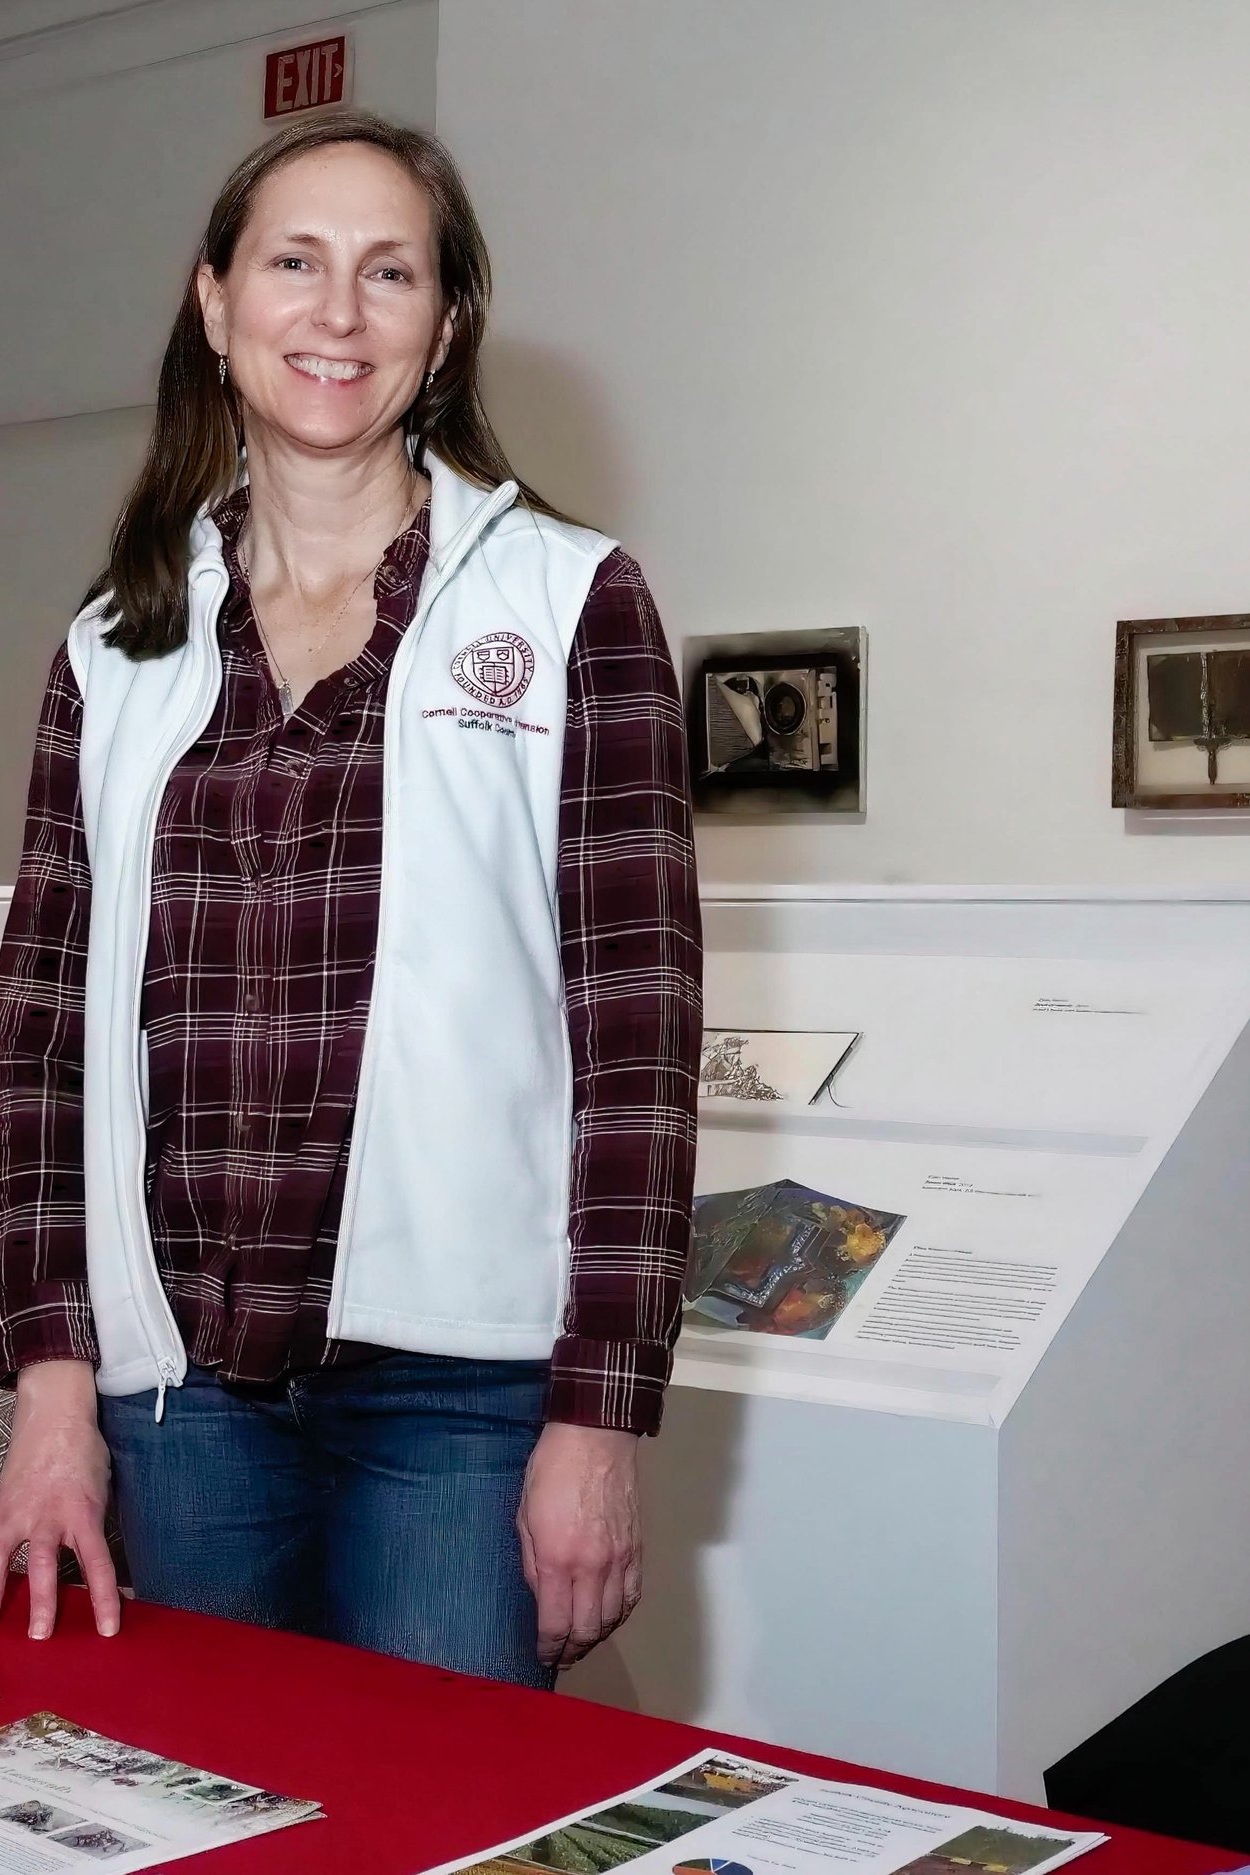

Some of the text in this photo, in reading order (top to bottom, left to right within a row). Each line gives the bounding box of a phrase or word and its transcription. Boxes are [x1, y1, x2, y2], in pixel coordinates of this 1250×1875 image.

[276, 43, 338, 112] EXIT
[422, 707, 458, 718] Cornell
[458, 718, 493, 732] Suffolk
